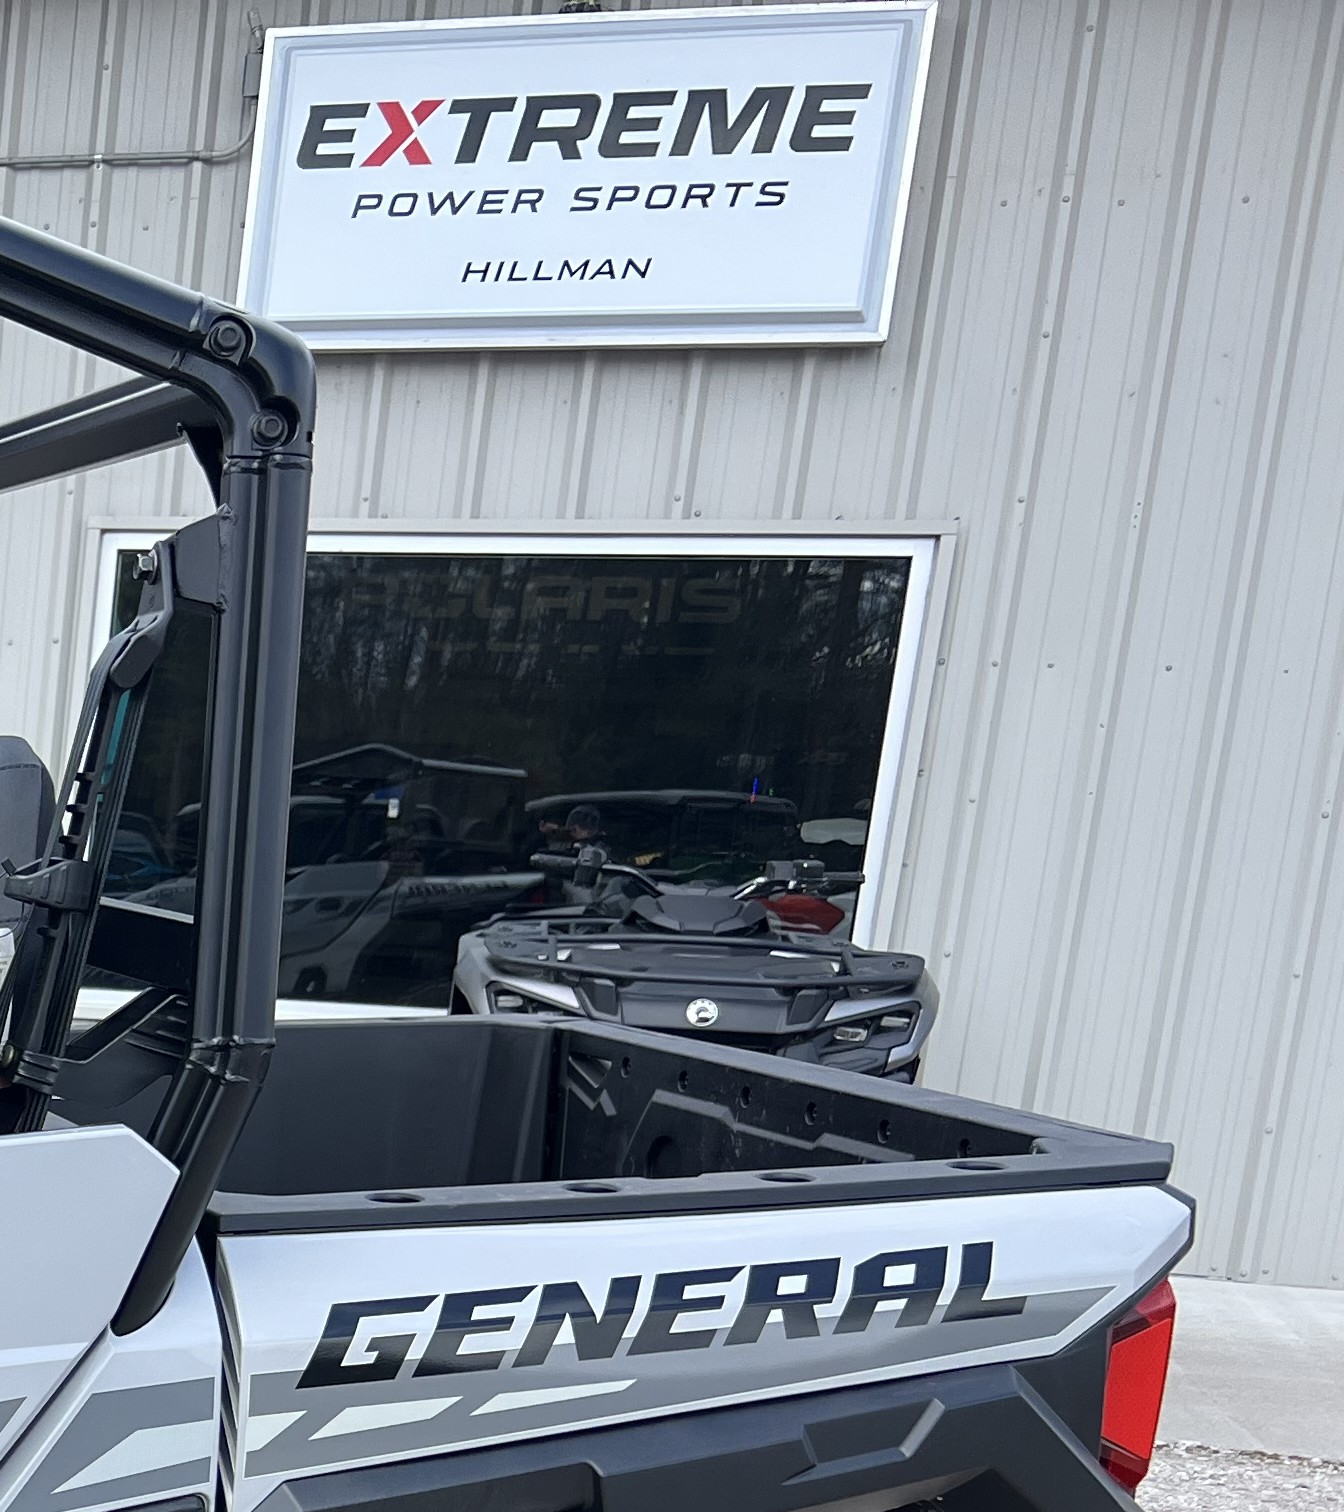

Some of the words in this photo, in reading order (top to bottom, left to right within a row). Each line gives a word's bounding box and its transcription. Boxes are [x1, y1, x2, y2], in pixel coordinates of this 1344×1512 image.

[297, 83, 873, 169] EXTREME
[352, 187, 544, 219] POWER
[569, 180, 790, 213] SPORTS
[461, 257, 653, 283] HILLMAN
[341, 573, 746, 624] POLARIS
[295, 1241, 1027, 1390] GENERAL
